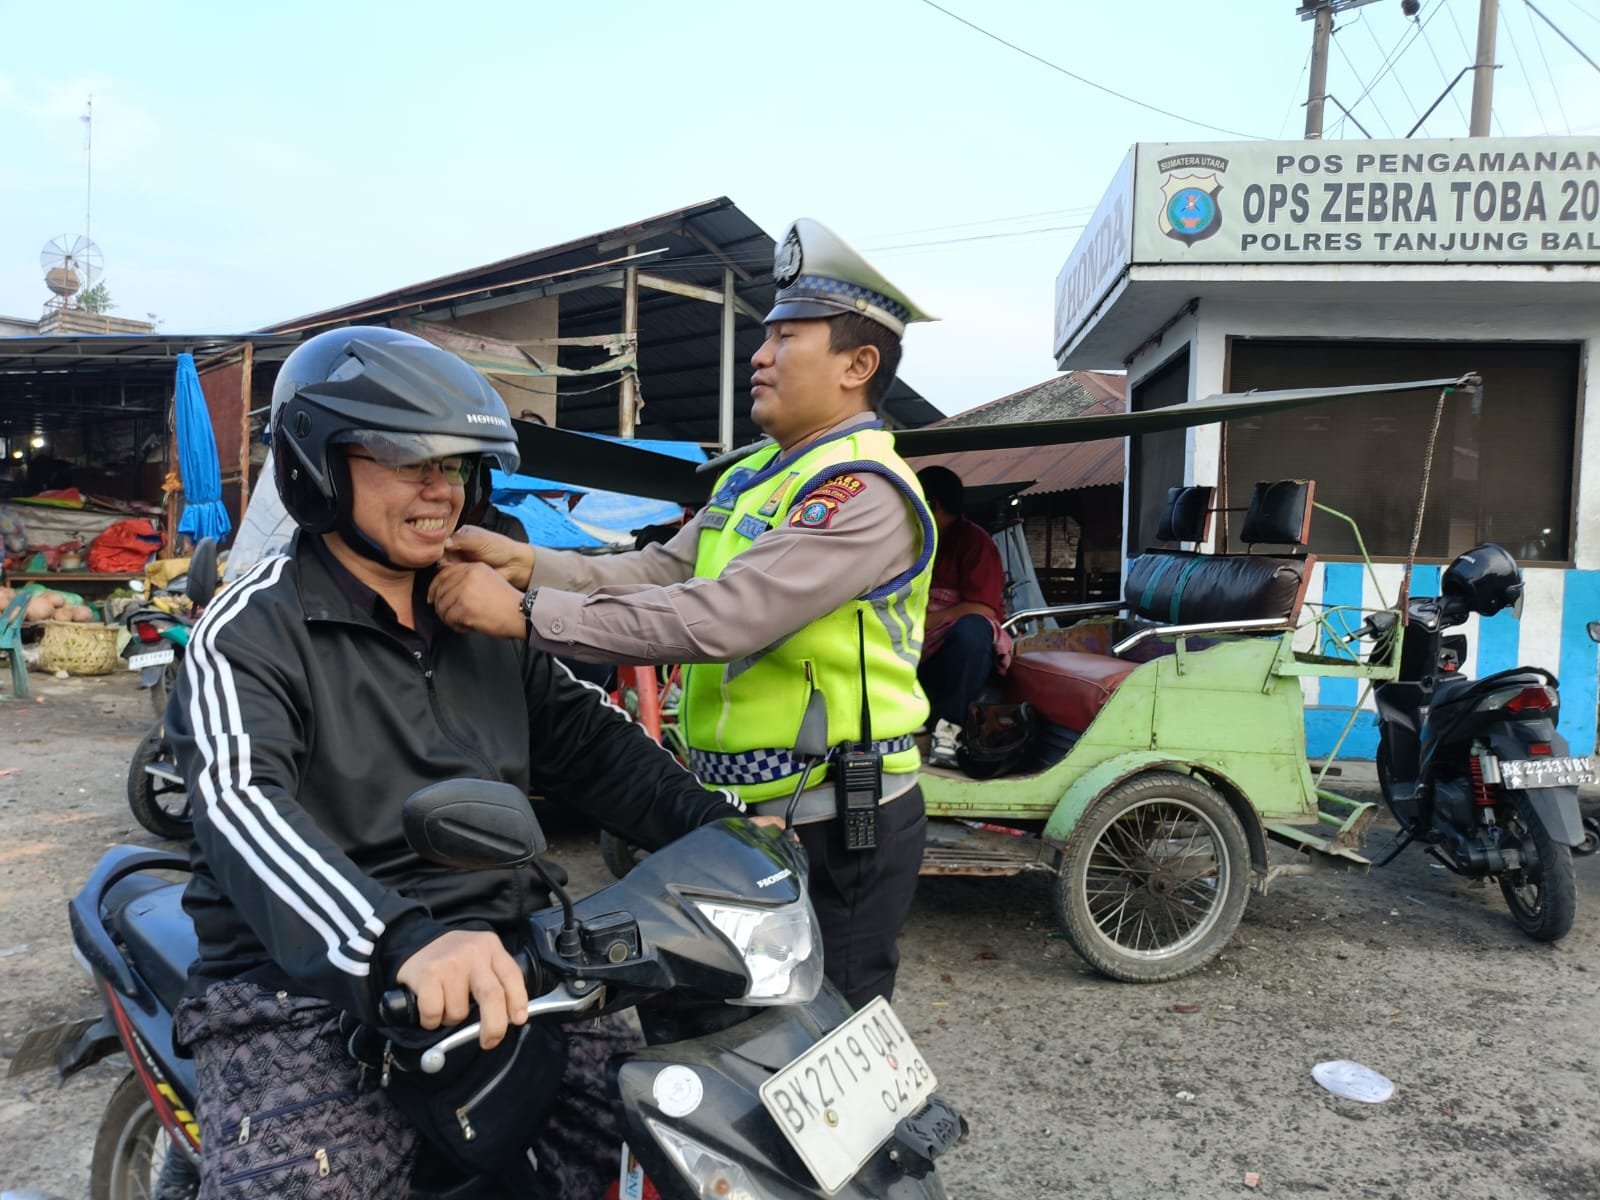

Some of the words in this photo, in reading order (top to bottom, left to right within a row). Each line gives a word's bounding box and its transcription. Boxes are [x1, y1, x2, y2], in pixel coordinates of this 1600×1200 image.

[1161, 157, 1199, 171] SUMATERA
[1201, 156, 1225, 170] UTARA
[1276, 154, 1343, 174] POS
[1356, 152, 1600, 173] PENGAMANAN
[1243, 183, 1310, 224] OPS
[1320, 182, 1437, 223] ZEBRA
[1450, 180, 1547, 222] TOBA
[1241, 232, 1362, 252] POLRES
[1374, 232, 1528, 251] TANJUNG
[1541, 231, 1600, 251] BAL
[1066, 194, 1126, 326] HONDA
[756, 868, 792, 889] HONDA
[773, 1077, 816, 1134] BK
[805, 1036, 871, 1109] 2719
